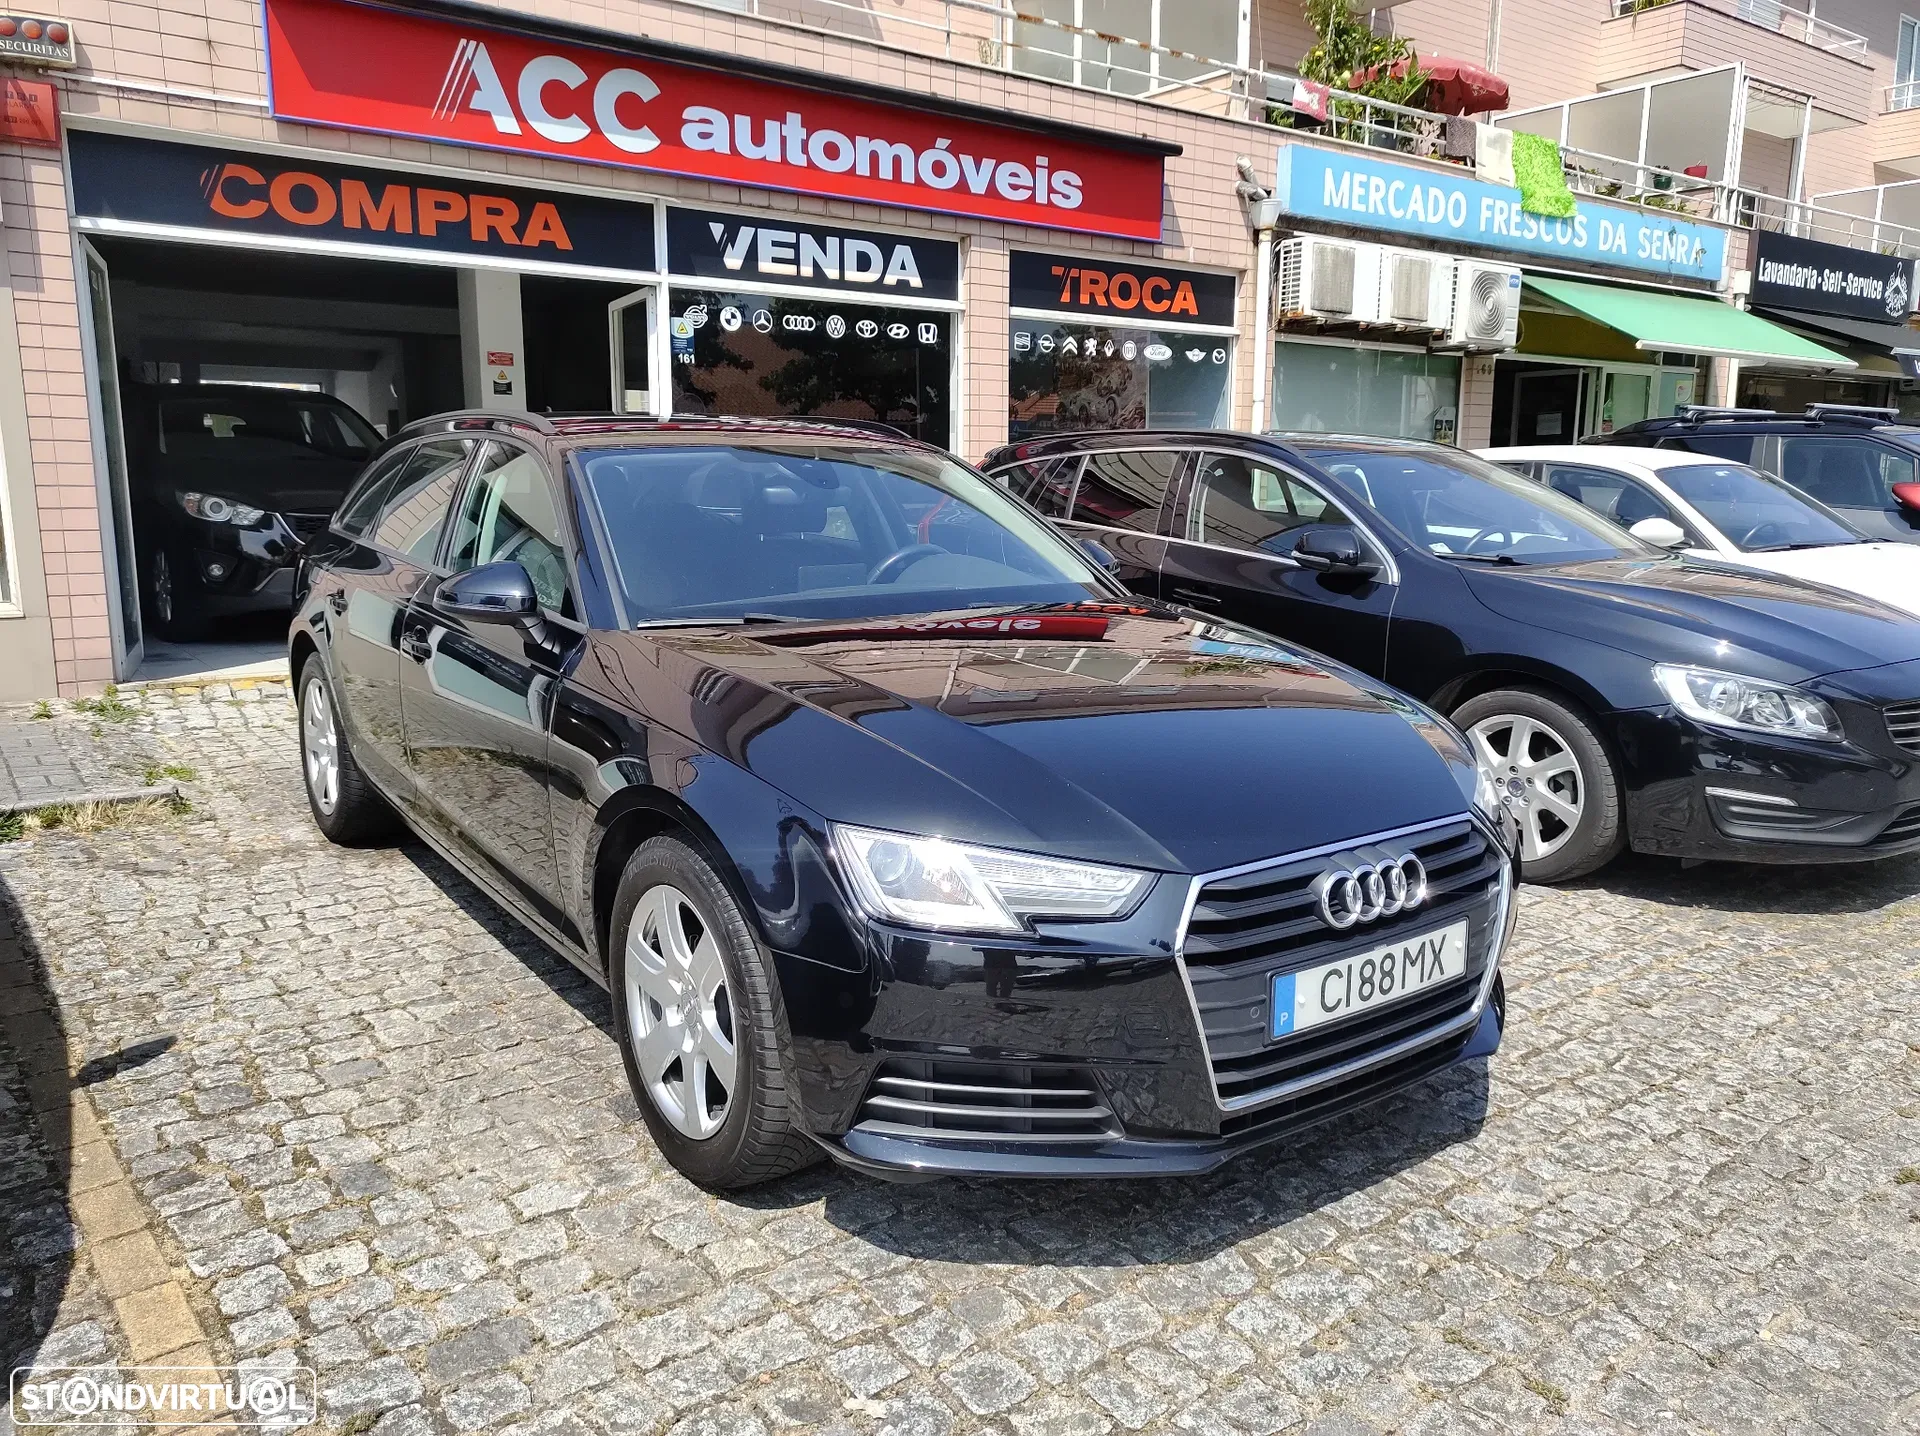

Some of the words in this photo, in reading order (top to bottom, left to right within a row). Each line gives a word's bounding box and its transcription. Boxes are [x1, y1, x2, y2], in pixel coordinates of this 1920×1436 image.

[0, 39, 69, 58] SECURITAS
[431, 38, 661, 154] ACC
[680, 105, 1083, 209] automóveis
[201, 163, 574, 251] COMPRA
[1323, 167, 1467, 228] MERCADO
[1480, 197, 1588, 249] FRESCOS
[1599, 223, 1627, 255] DA
[1637, 226, 1704, 266] SENRA
[708, 221, 923, 289] VENDA
[1051, 266, 1198, 316] TROCA
[678, 353, 695, 364] 161
[1280, 1012, 1289, 1026] P
